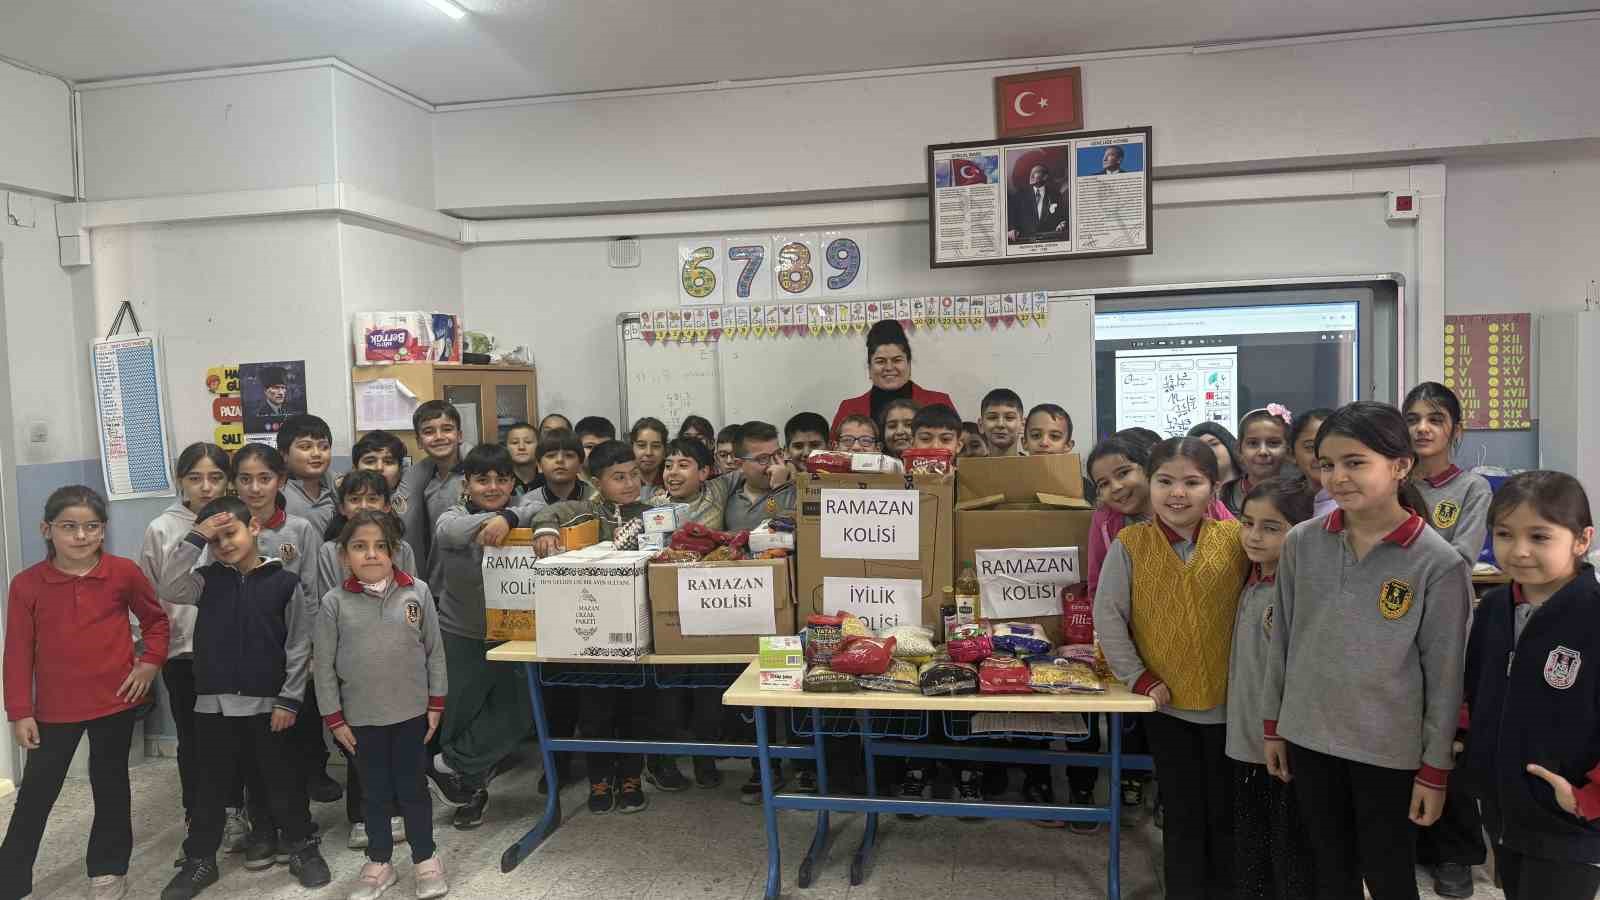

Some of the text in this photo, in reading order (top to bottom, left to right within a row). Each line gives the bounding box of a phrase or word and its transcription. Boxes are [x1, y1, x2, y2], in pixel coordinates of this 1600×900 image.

[682, 238, 860, 297] 6 7 8 9
[1502, 322, 1515, 333] XI
[1503, 334, 1520, 344] XII
[1502, 345, 1523, 355] XIII
[1459, 356, 1472, 367] IV
[1503, 355, 1525, 365] XIV
[1459, 367, 1468, 378] V
[1503, 366, 1520, 376] XV
[1459, 378, 1472, 388] VI
[1504, 377, 1524, 386] XVI
[1459, 388, 1476, 398] VII
[1461, 399, 1480, 409] VIII
[1503, 398, 1529, 409] XVIII
[1503, 409, 1522, 418] XIX
[1503, 419, 1520, 429] XX
[826, 499, 913, 515] RAMAZAN
[843, 525, 896, 543] KOLİSİ
[982, 558, 1073, 575] RAMAZAN
[688, 577, 764, 591] RAMAZAN
[850, 585, 897, 604] İYİLİK
[1002, 582, 1057, 600] KOLİSİ
[700, 594, 753, 609] KOLİSİ
[858, 614, 898, 631] OLİSİ
